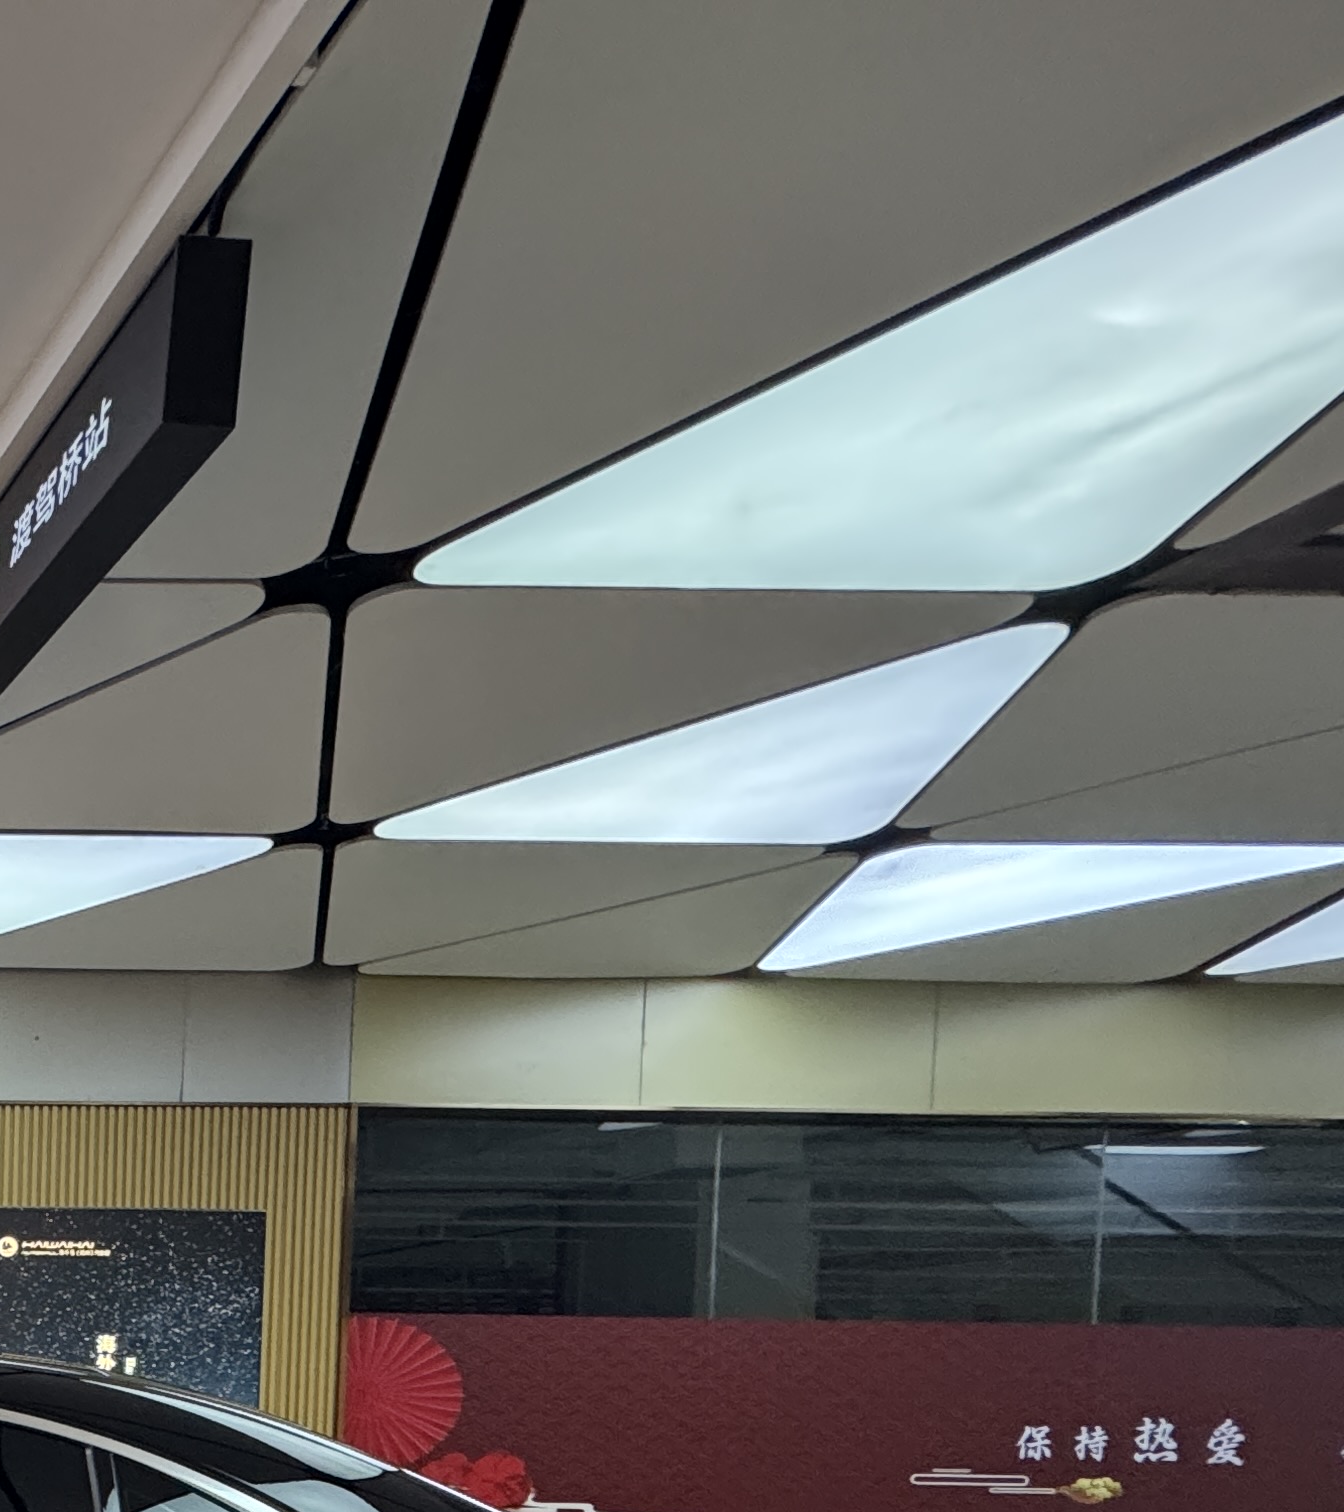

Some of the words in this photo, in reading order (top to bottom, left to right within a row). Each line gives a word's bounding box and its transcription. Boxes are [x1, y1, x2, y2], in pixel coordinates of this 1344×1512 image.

[10, 397, 112, 567] 渡驾桥站
[1016, 1417, 1246, 1467] 保持热爱
